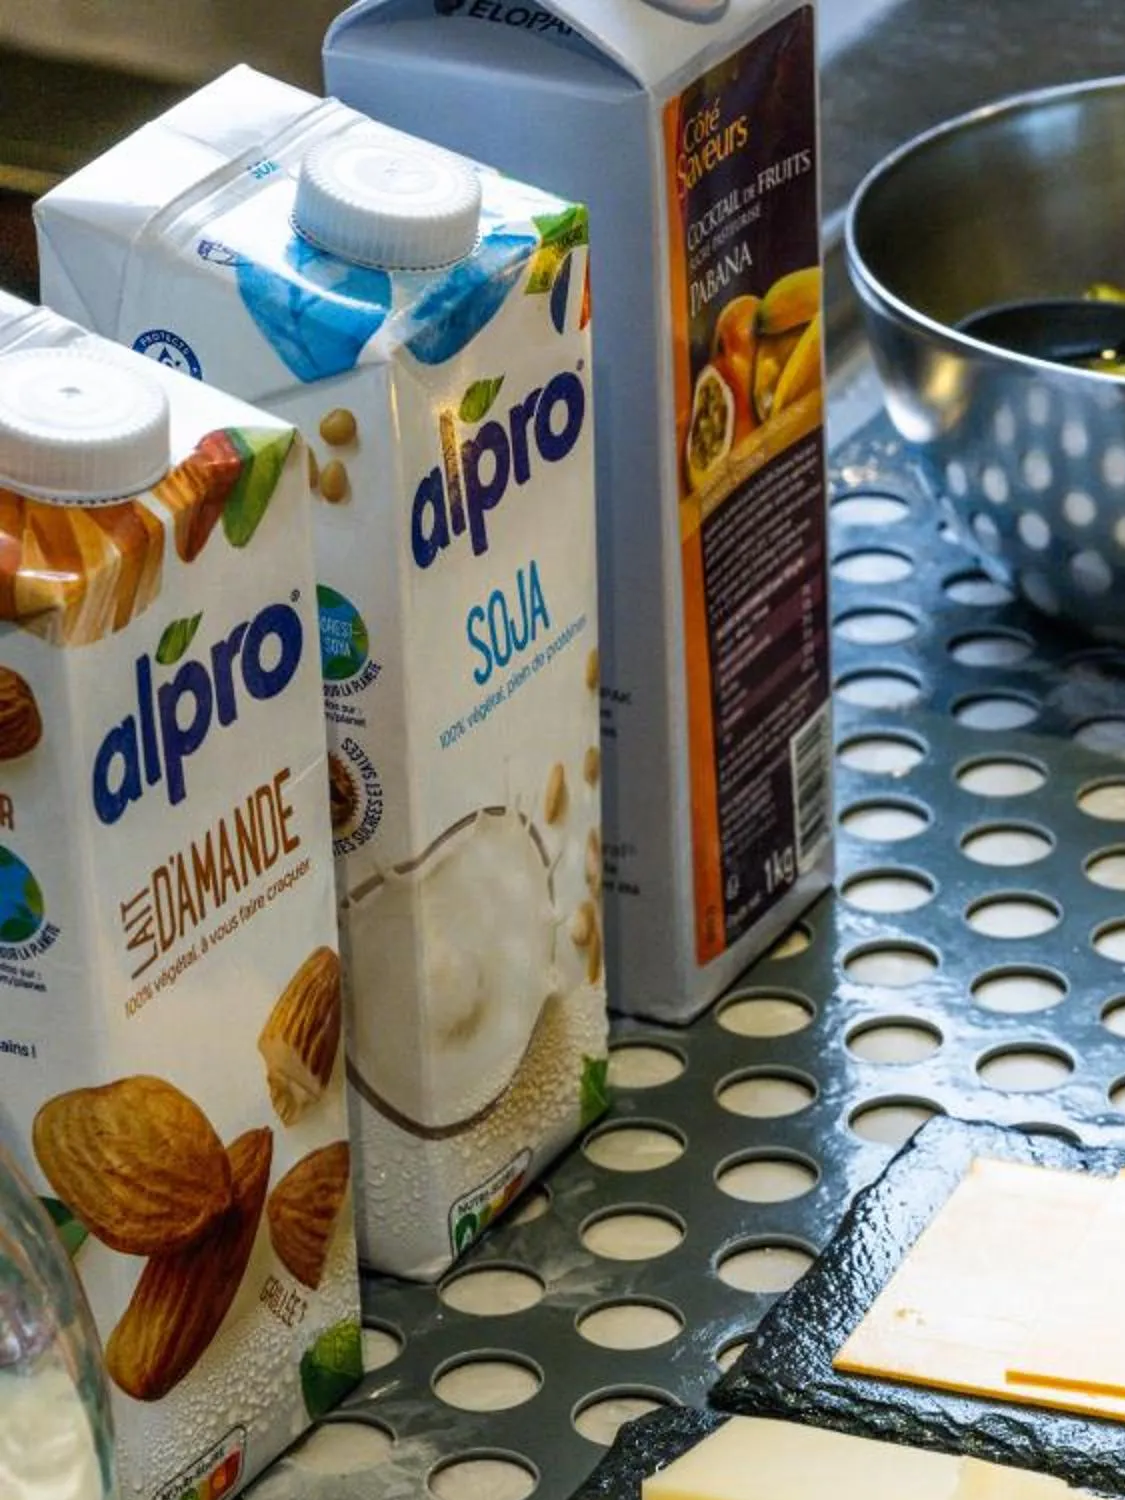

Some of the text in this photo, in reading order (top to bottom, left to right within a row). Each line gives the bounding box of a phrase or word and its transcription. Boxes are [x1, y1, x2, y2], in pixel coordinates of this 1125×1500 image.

[758, 149, 812, 196] FRUITS
[690, 240, 754, 319] PABANA
[411, 371, 585, 570] alpro
[467, 560, 549, 685] SOJA
[93, 604, 304, 825] alpro
[120, 767, 301, 981] LAIT D'AMANDE
